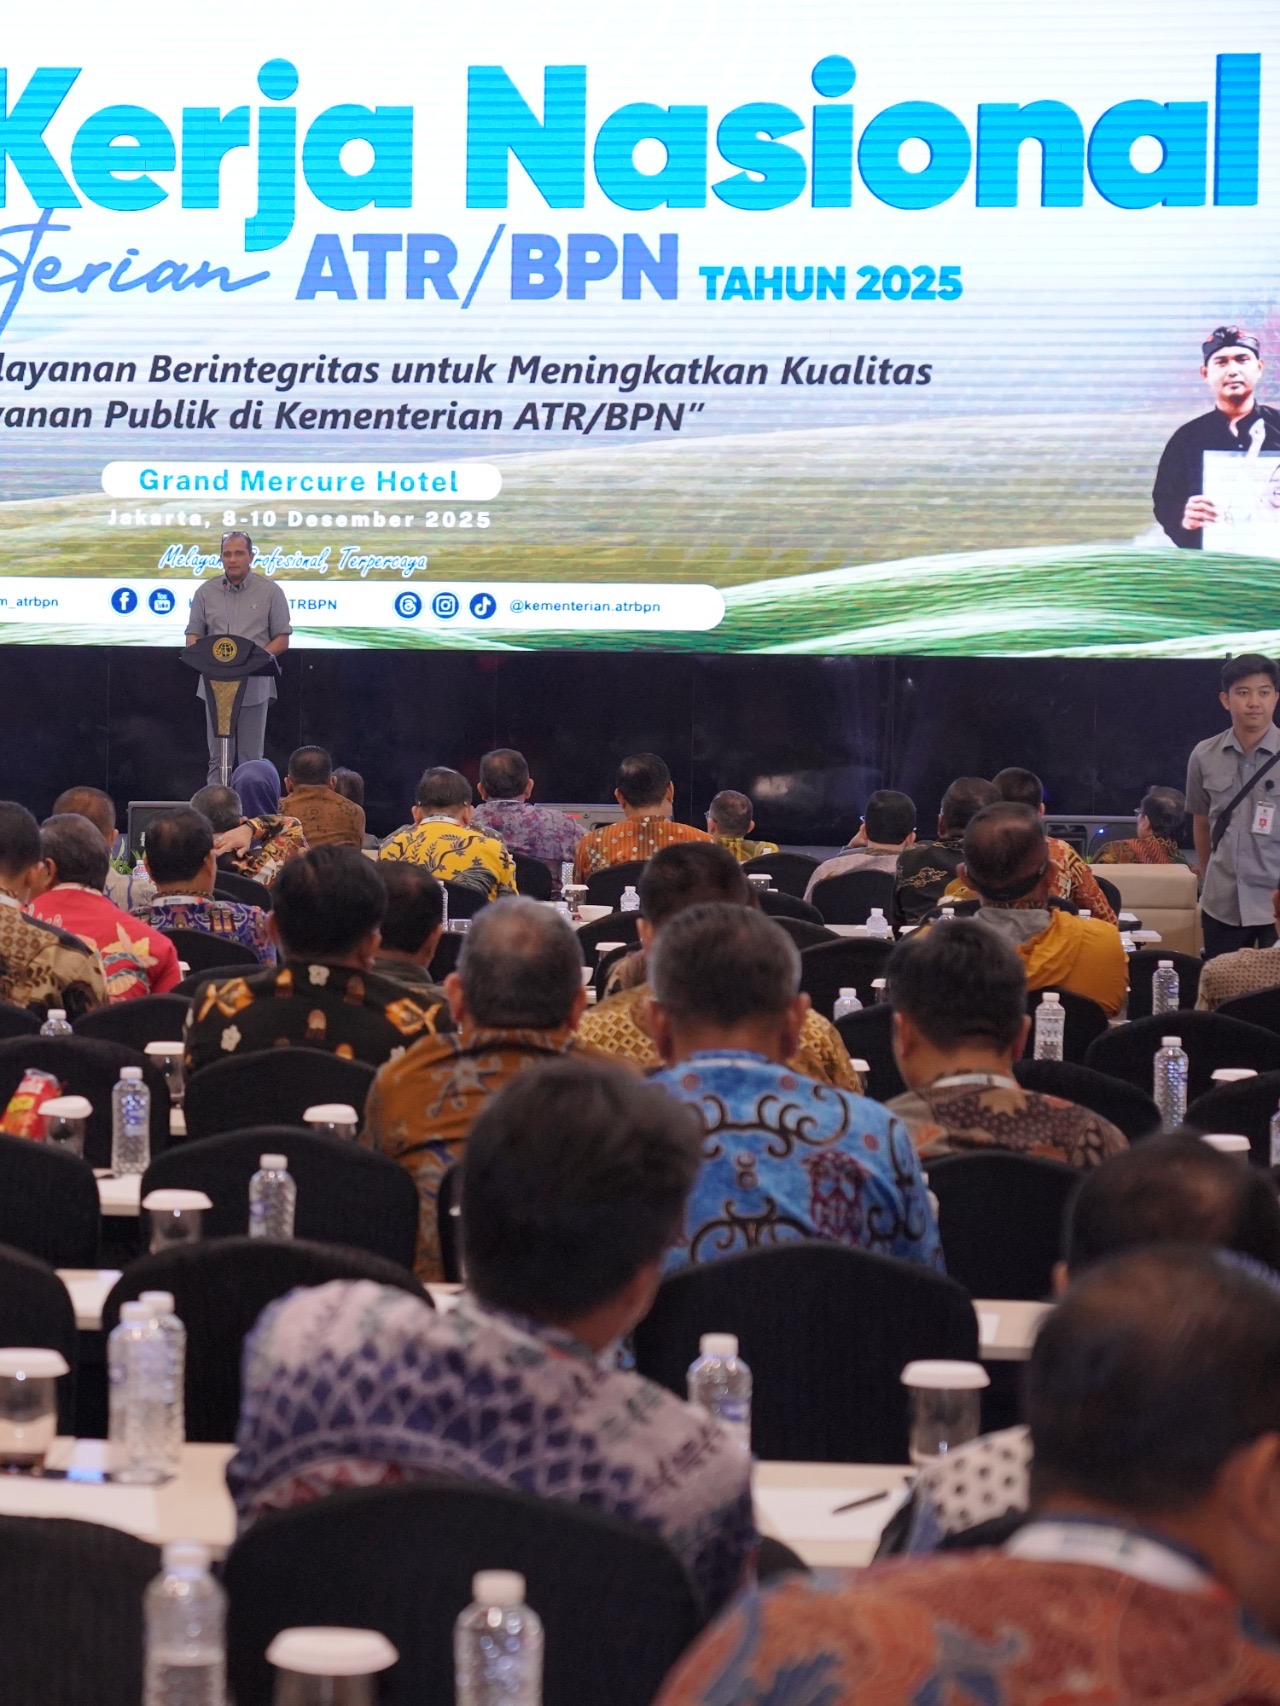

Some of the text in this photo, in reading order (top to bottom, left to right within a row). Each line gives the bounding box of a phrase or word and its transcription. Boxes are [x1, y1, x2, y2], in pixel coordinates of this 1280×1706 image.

[466, 53, 1261, 211] Nasional
[295, 223, 679, 309] ATR/BPN
[699, 266, 847, 301] TAHUN
[856, 265, 964, 301] 2025
[148, 354, 380, 392] Berintegritas
[391, 354, 497, 384] untuk
[507, 355, 768, 393] Meningkatkan
[781, 355, 932, 385] Kualitas
[104, 399, 219, 430] Publik
[229, 400, 265, 430] di
[274, 401, 503, 430] Kementerian
[514, 403, 705, 435] ATR/BPN”
[139, 468, 458, 492] Grand Mercure Hotel
[107, 508, 491, 529] Jakarta, 8-10 Desember 2025
[339, 548, 426, 576] Terpercaya
[289, 599, 337, 610] TRBPN
[509, 599, 661, 614] @kementerian.atrbpn
